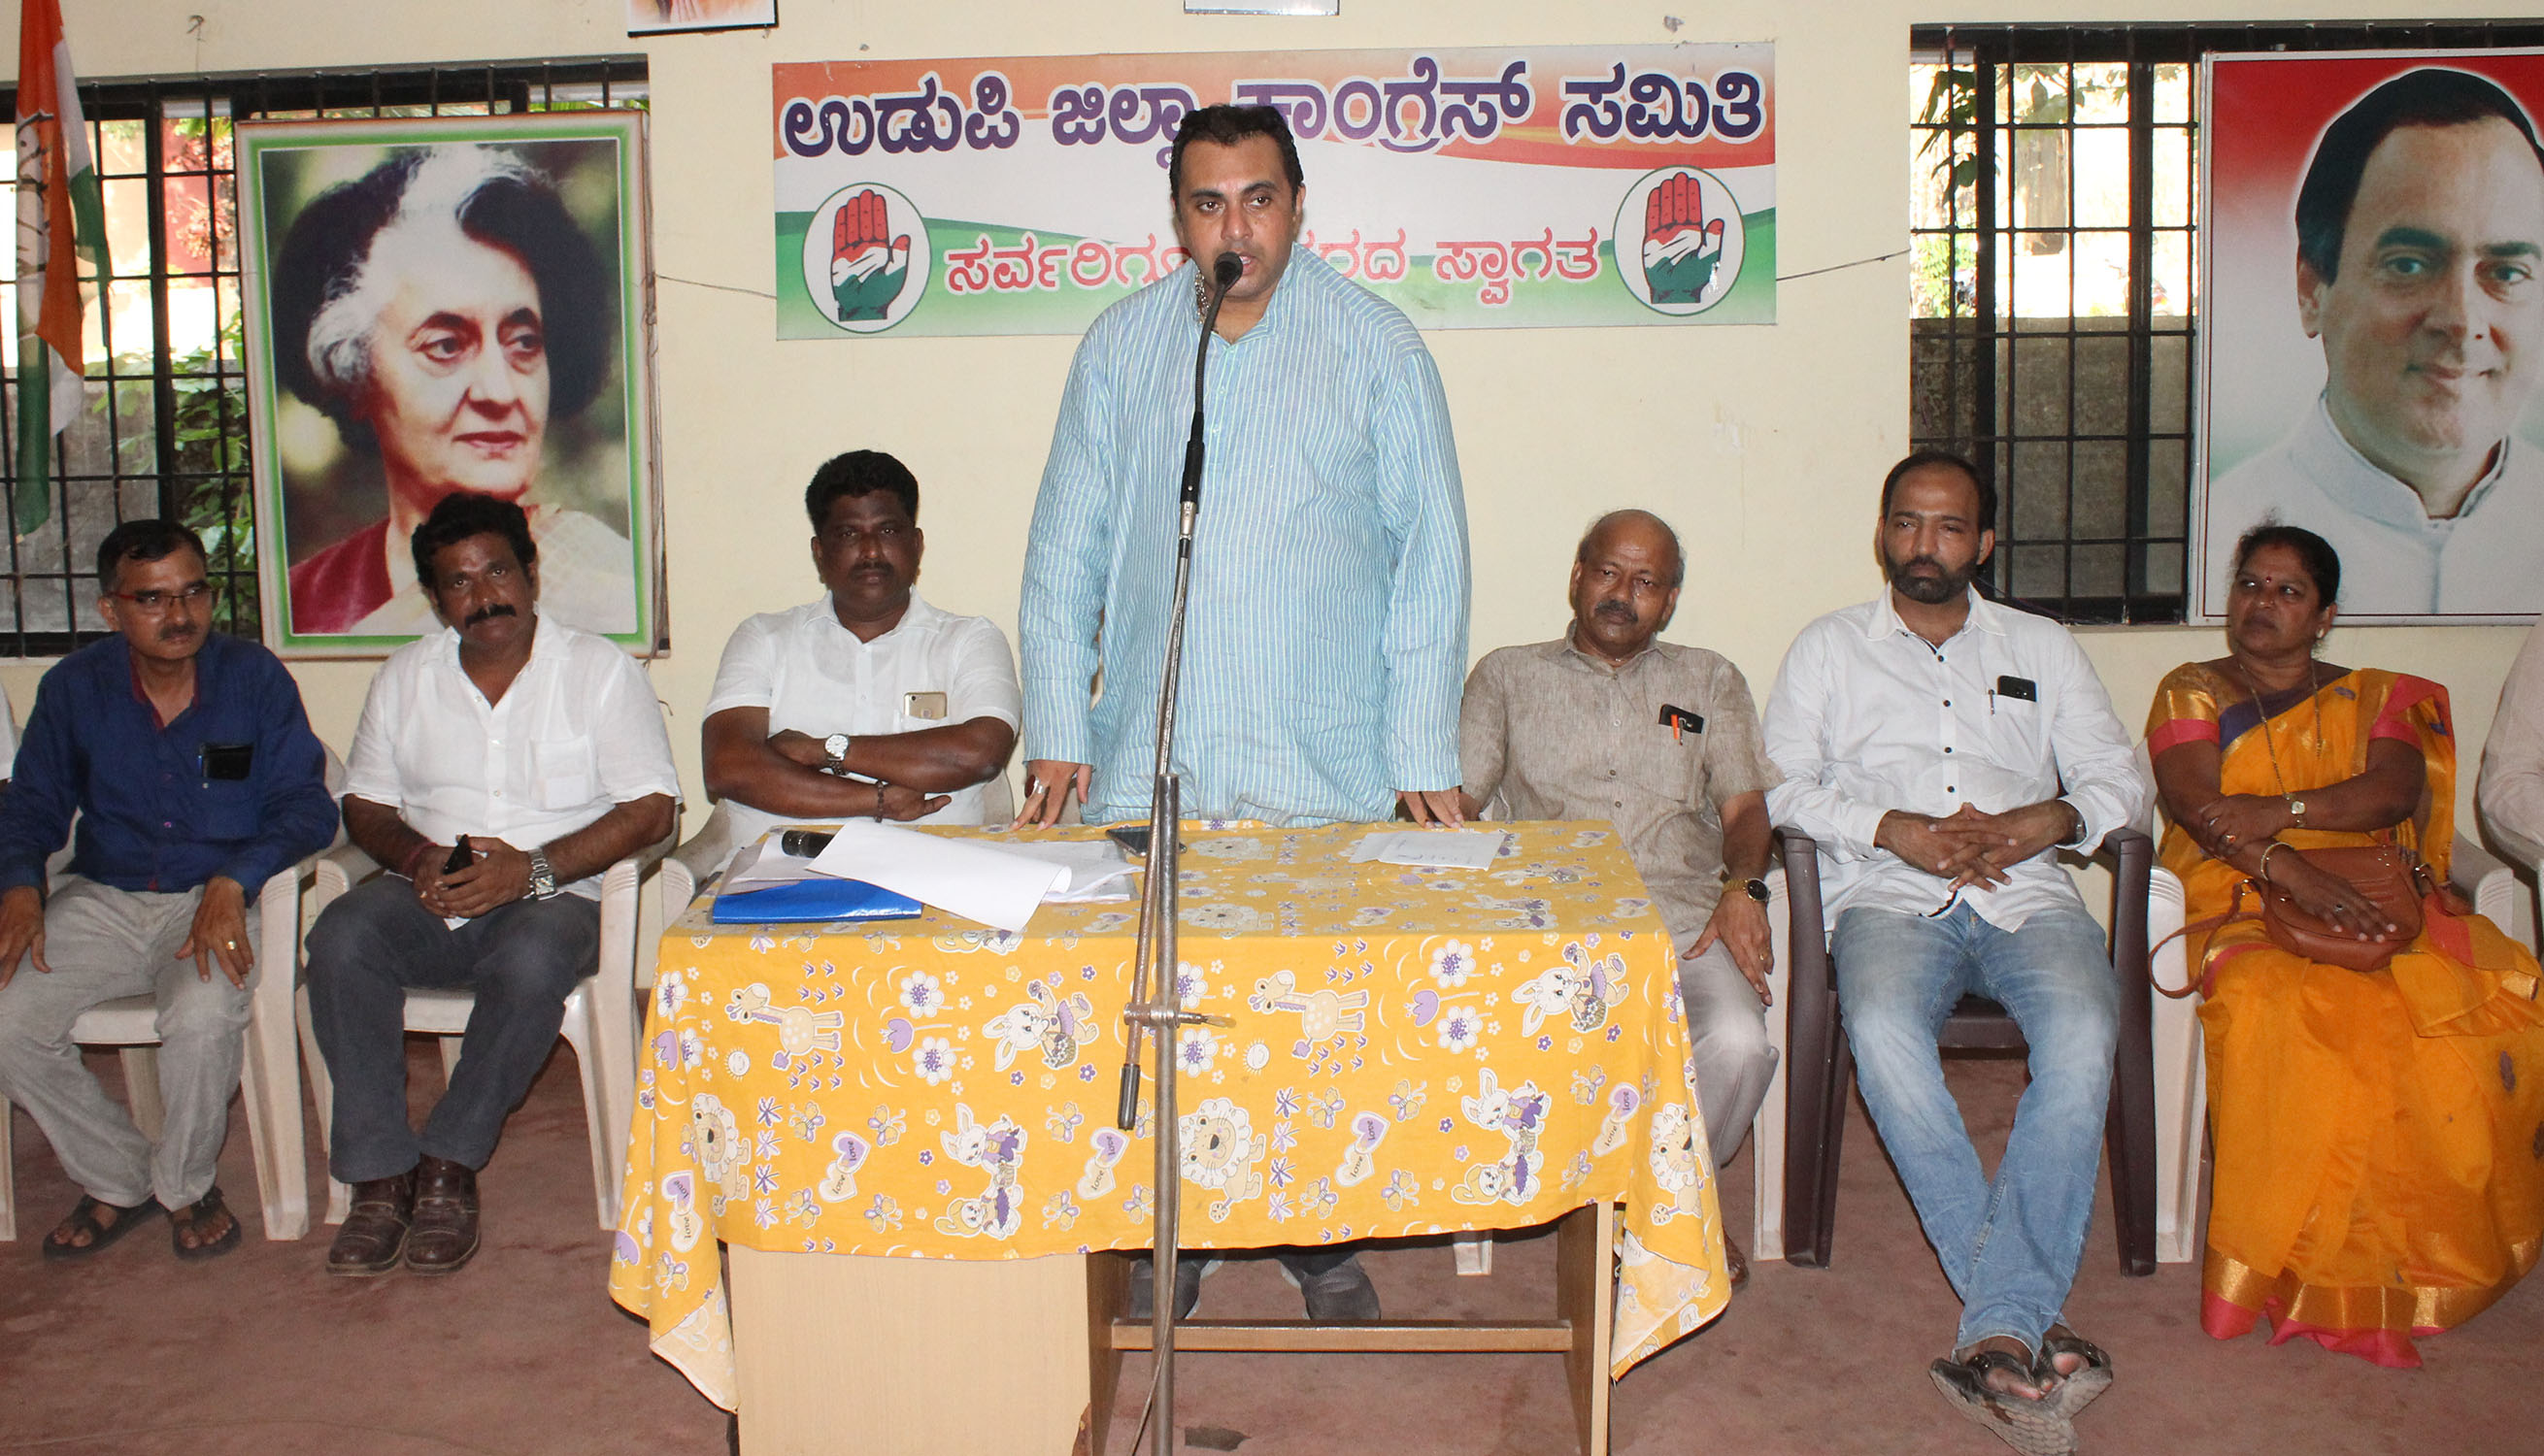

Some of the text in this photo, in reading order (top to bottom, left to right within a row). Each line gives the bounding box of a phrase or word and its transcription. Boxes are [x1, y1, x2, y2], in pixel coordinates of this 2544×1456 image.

[785, 76, 1020, 155] ಉಡುಪಿ
[1565, 62, 1761, 140] ಸಮಿತಿ
[1437, 227, 1598, 303] ಸ್ವಾಗತ
